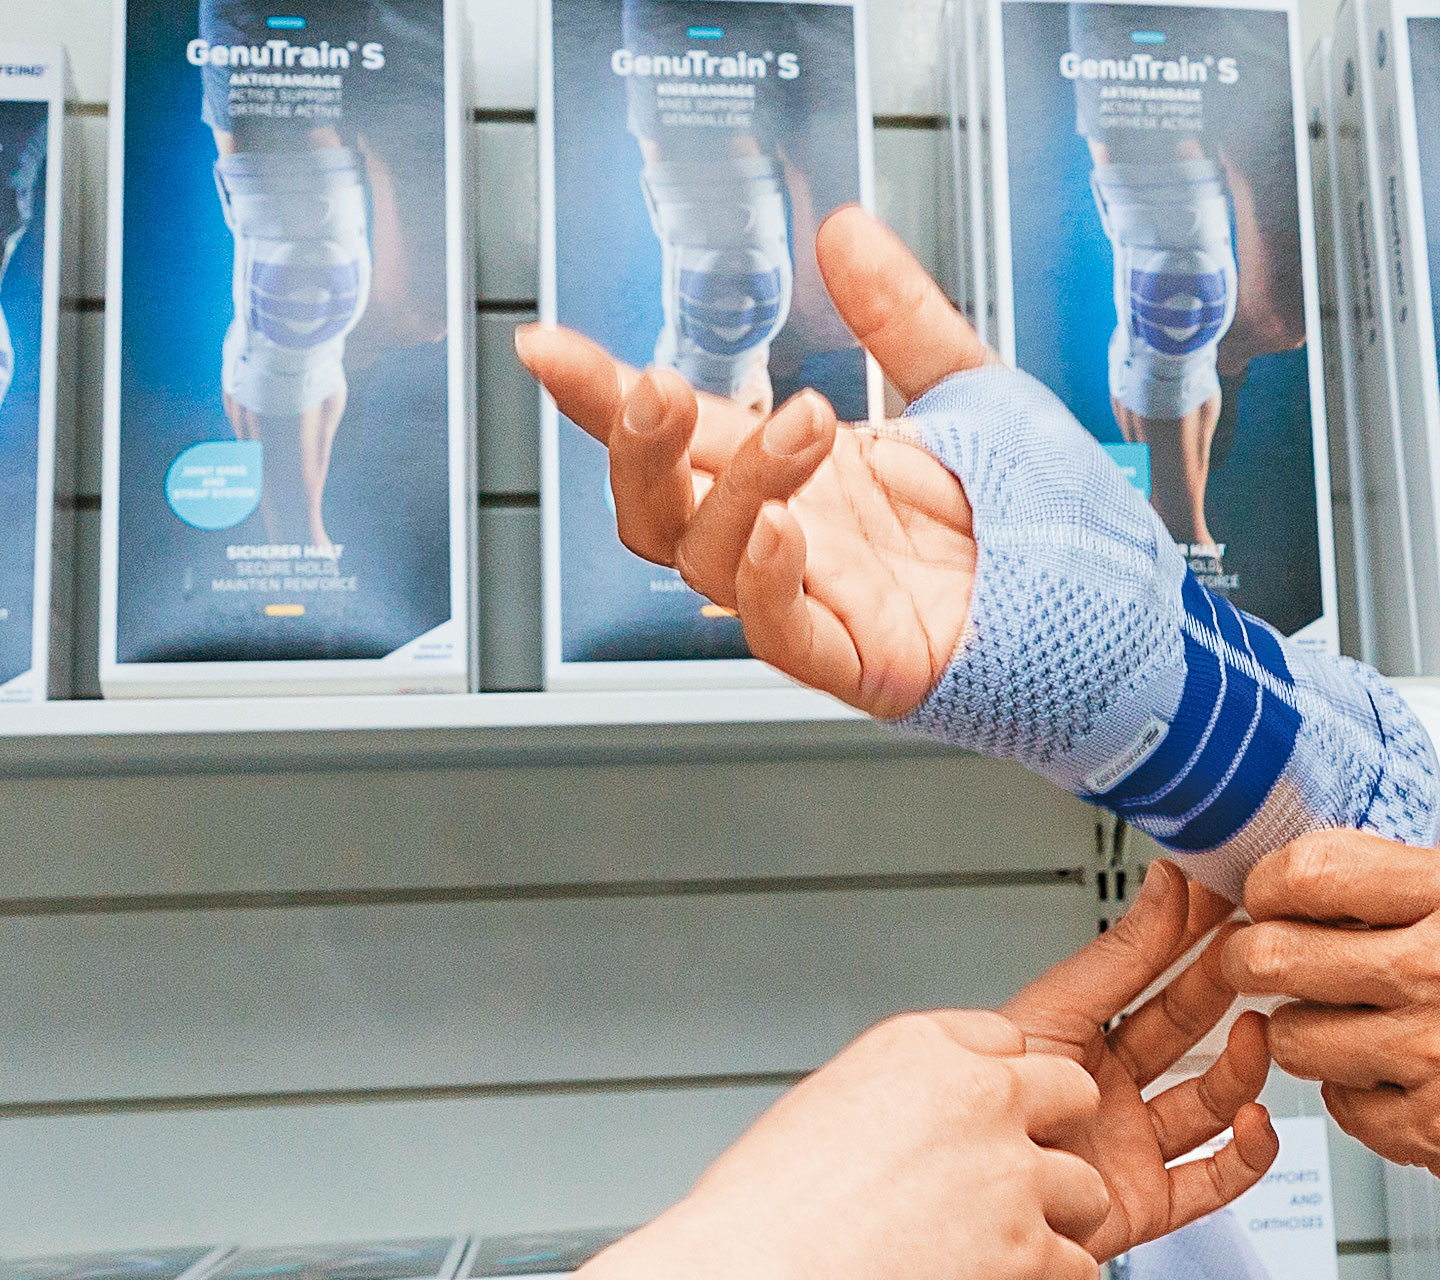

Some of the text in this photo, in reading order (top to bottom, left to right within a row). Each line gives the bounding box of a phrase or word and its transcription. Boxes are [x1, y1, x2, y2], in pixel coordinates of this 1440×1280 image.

[361, 42, 386, 70] S
[777, 52, 800, 80] S
[1217, 57, 1239, 84] S
